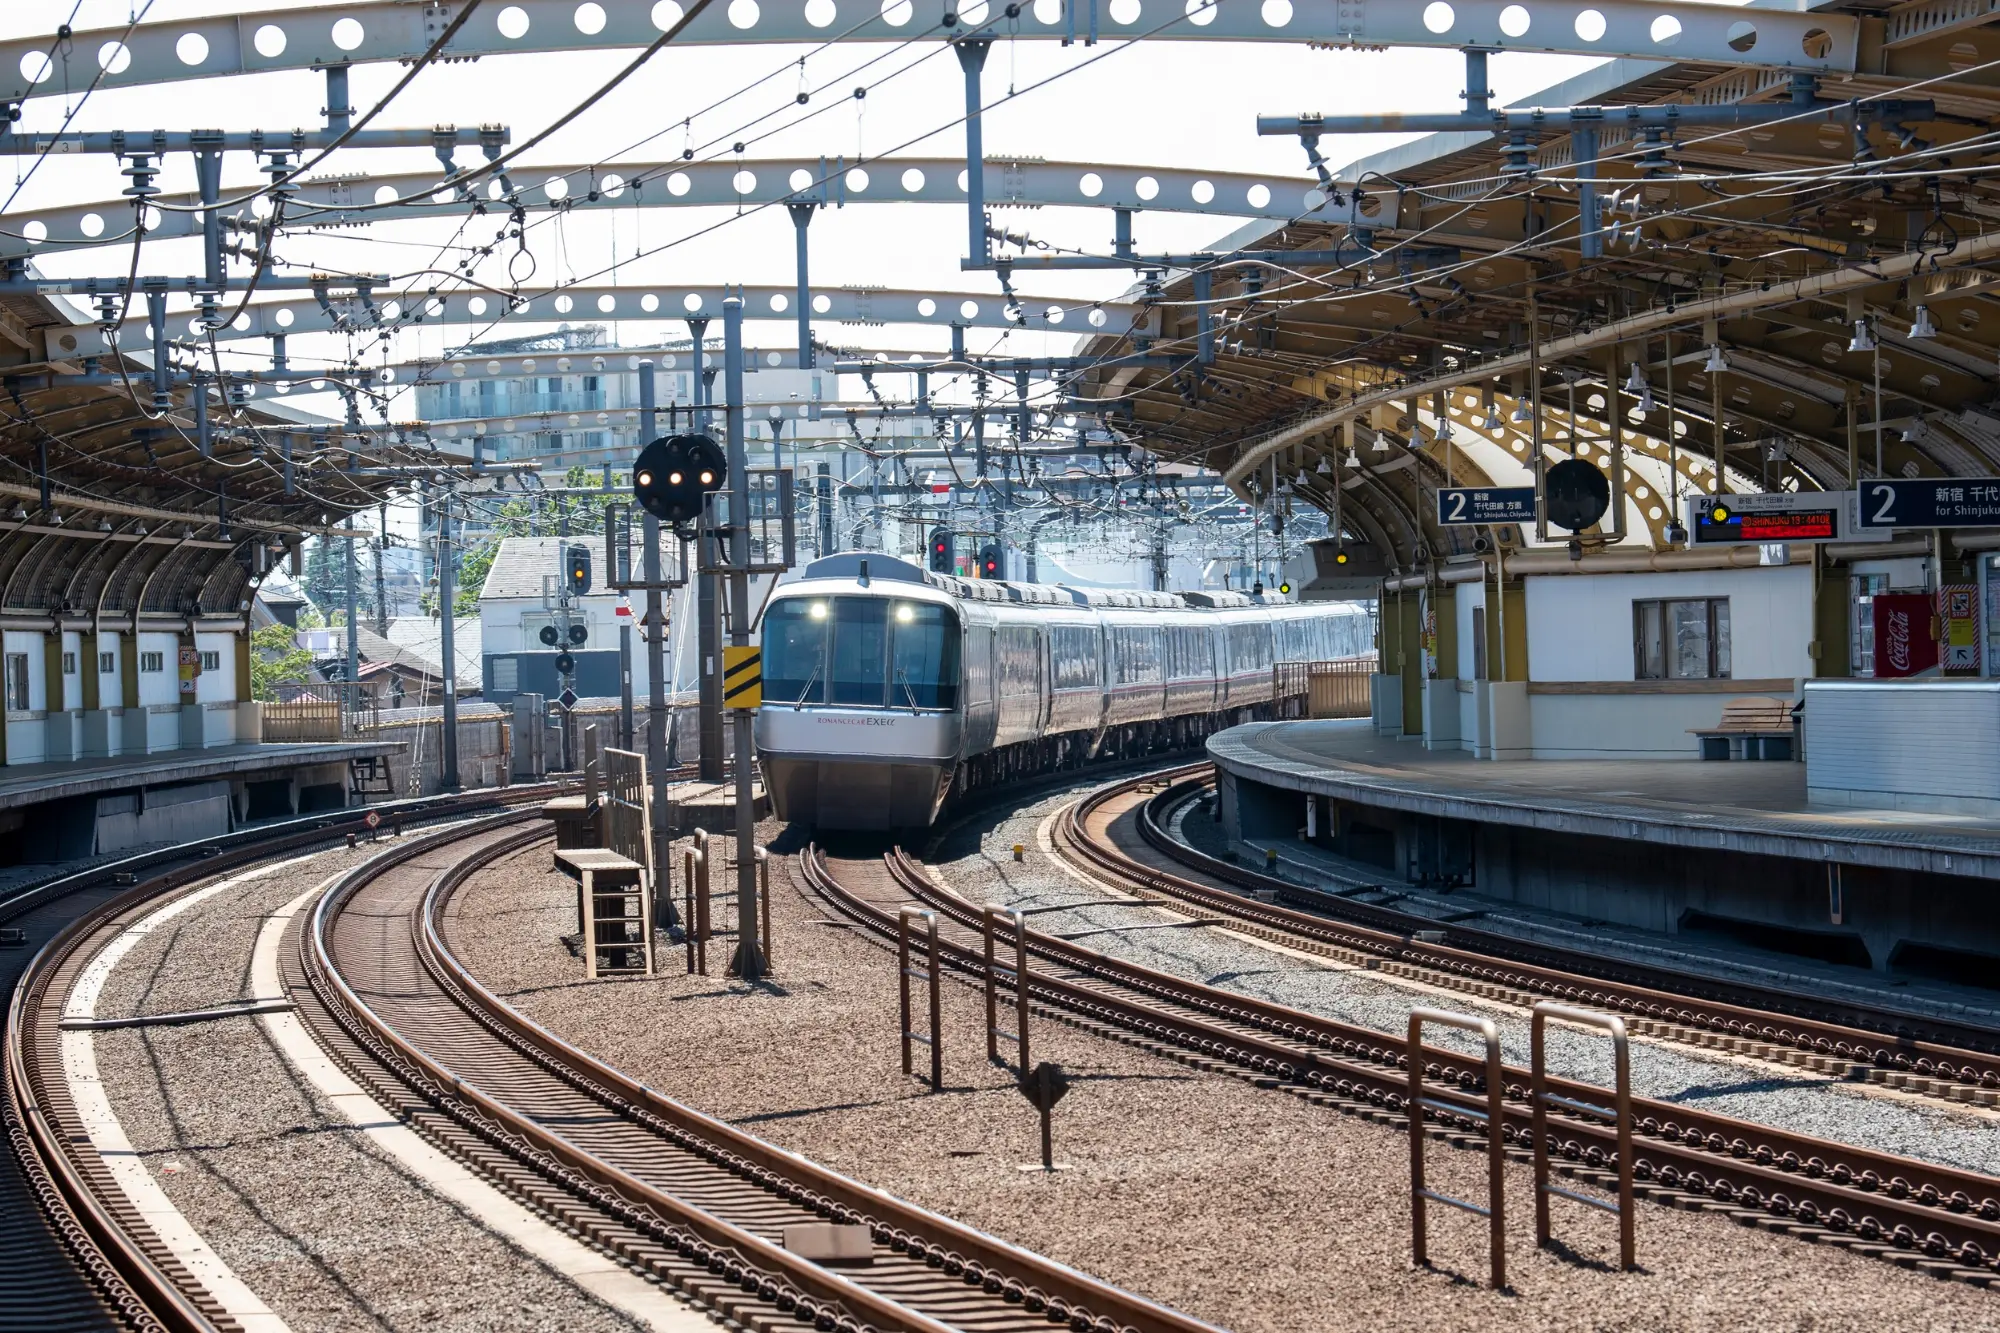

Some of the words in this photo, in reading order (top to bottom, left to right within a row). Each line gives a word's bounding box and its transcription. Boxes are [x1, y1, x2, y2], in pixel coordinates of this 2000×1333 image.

[62, 142, 69, 153] 3
[1473, 493, 1489, 501] 新宿
[1935, 487, 1964, 502] 新宿
[1969, 486, 2000, 502] 千代
[1473, 502, 1505, 511] 千代田線
[1506, 501, 1522, 510] 方面
[1702, 499, 1711, 510] 2
[1738, 497, 1752, 505] 新宿
[1756, 496, 1784, 504] 千代田線
[1872, 485, 1897, 523] 2
[1448, 492, 1467, 521] 2
[1936, 505, 1951, 516] for
[1509, 510, 1532, 518] Chiyoda
[1751, 515, 1790, 526] SHINJUKU
[1888, 608, 1910, 671] Coca-Cola
